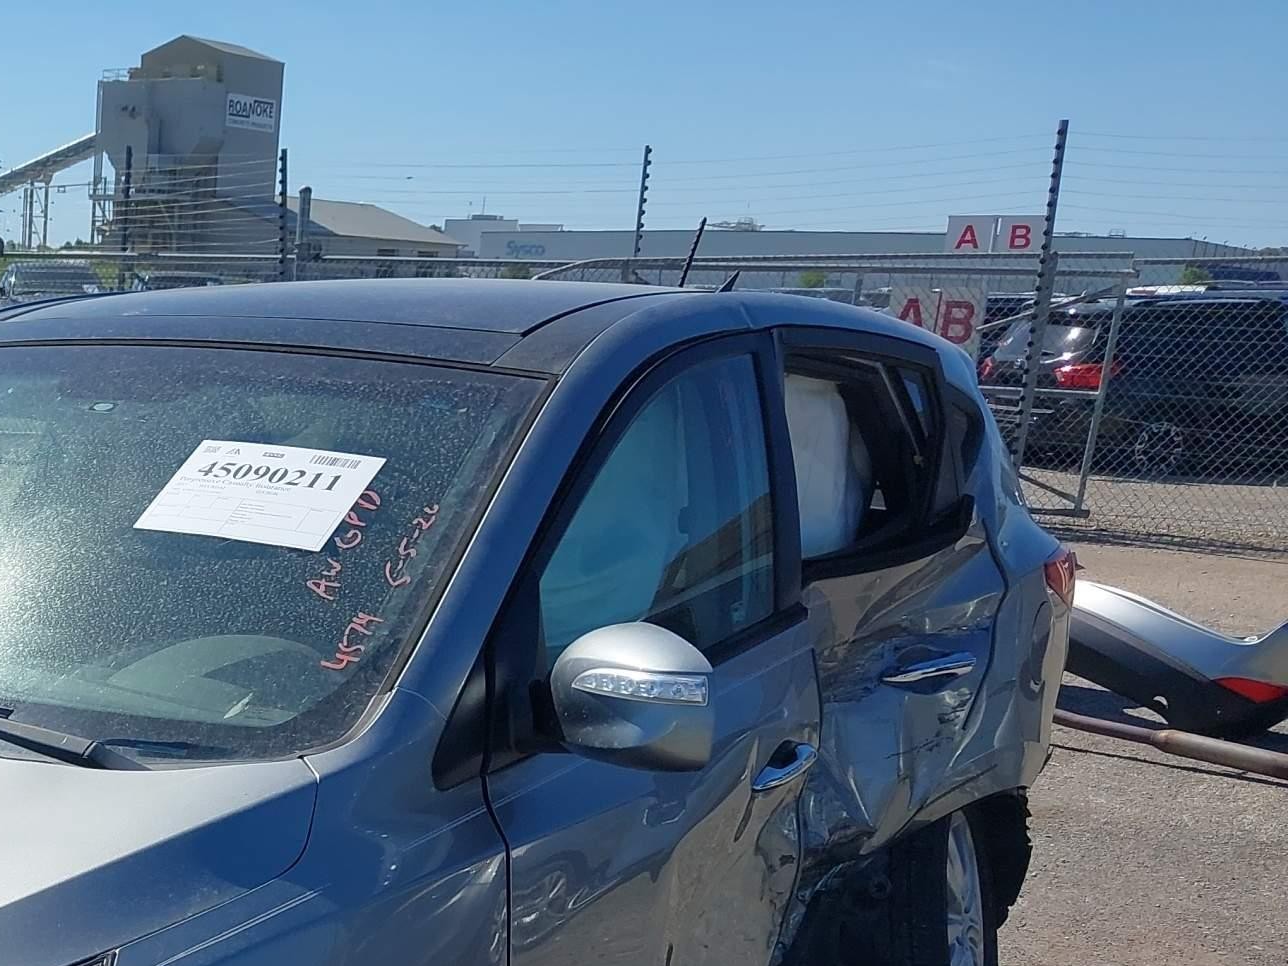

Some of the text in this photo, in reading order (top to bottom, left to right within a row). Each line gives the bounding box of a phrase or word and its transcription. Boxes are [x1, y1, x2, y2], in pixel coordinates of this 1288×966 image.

[228, 99, 274, 119] ROANOKE
[954, 224, 1032, 250] A B
[898, 297, 976, 345] A B
[197, 460, 343, 492] 45090211
